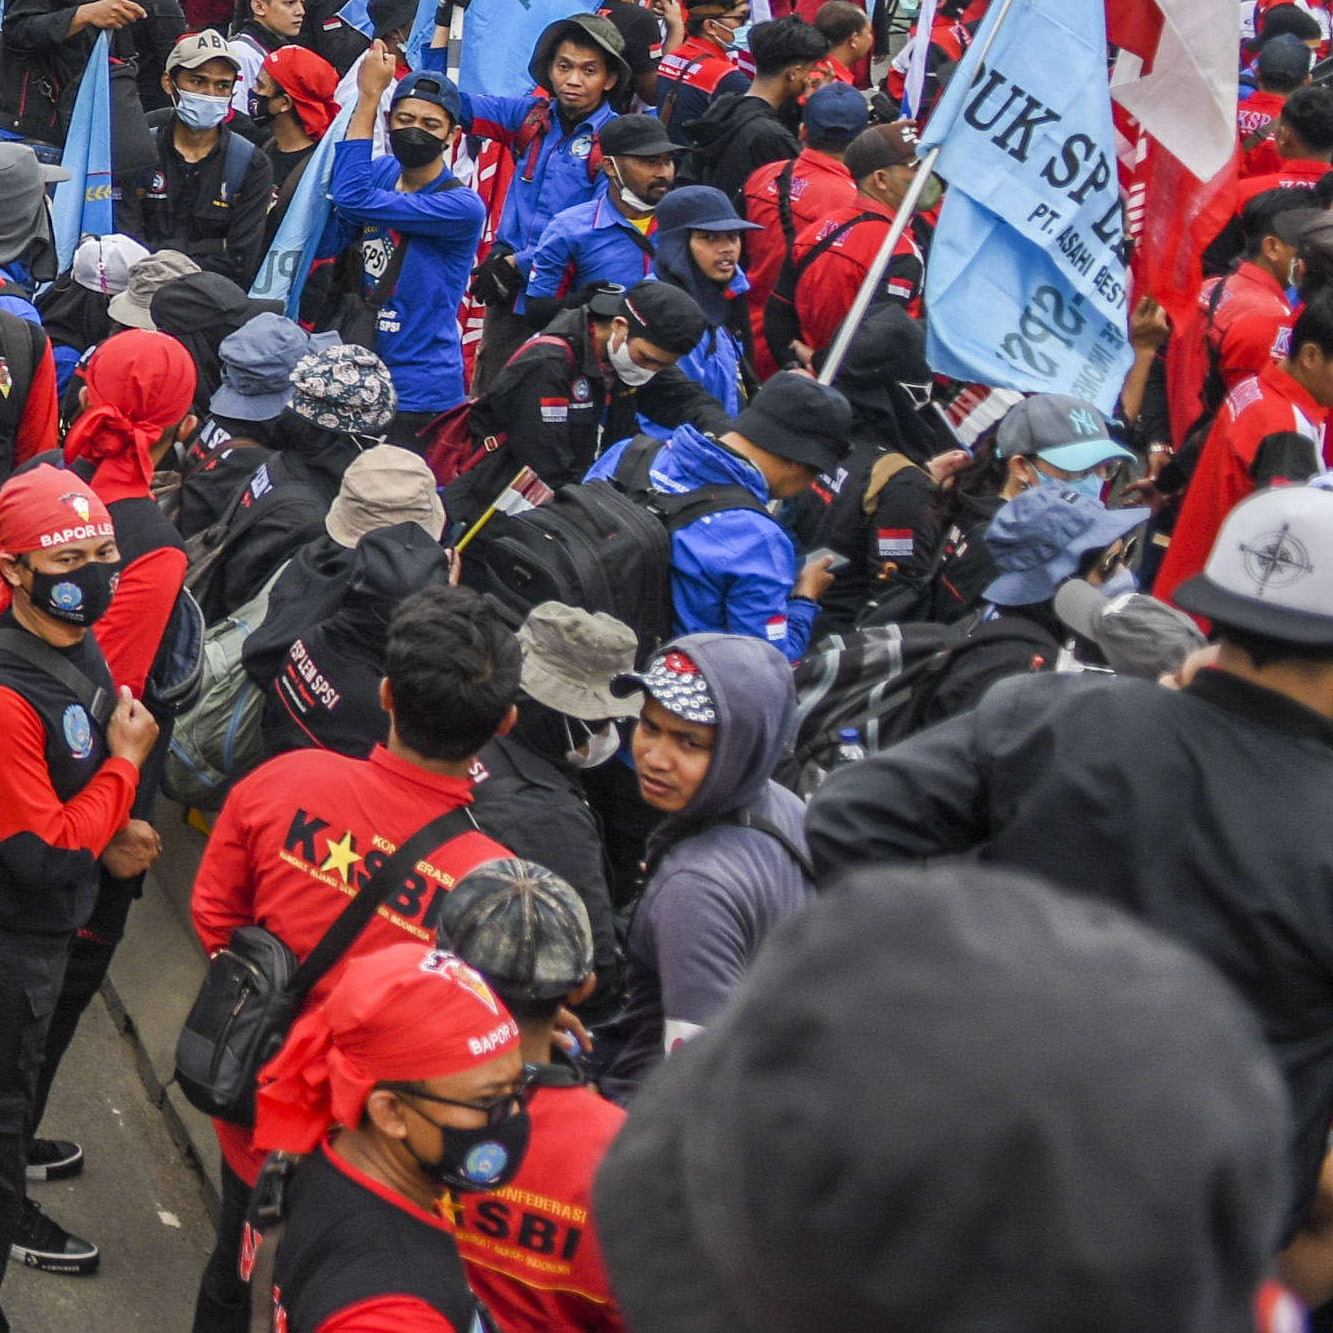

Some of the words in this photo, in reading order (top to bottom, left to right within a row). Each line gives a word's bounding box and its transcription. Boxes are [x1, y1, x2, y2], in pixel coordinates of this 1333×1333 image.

[1238, 110, 1272, 131] KSP
[1026, 203, 1061, 235] PT.
[363, 243, 384, 273] SPSI
[40, 524, 97, 547] BAPOR
[297, 654, 318, 684] LEM
[311, 674, 341, 710] SPSI
[389, 915, 431, 942] INDONESIA
[467, 1026, 511, 1056] BAPOR
